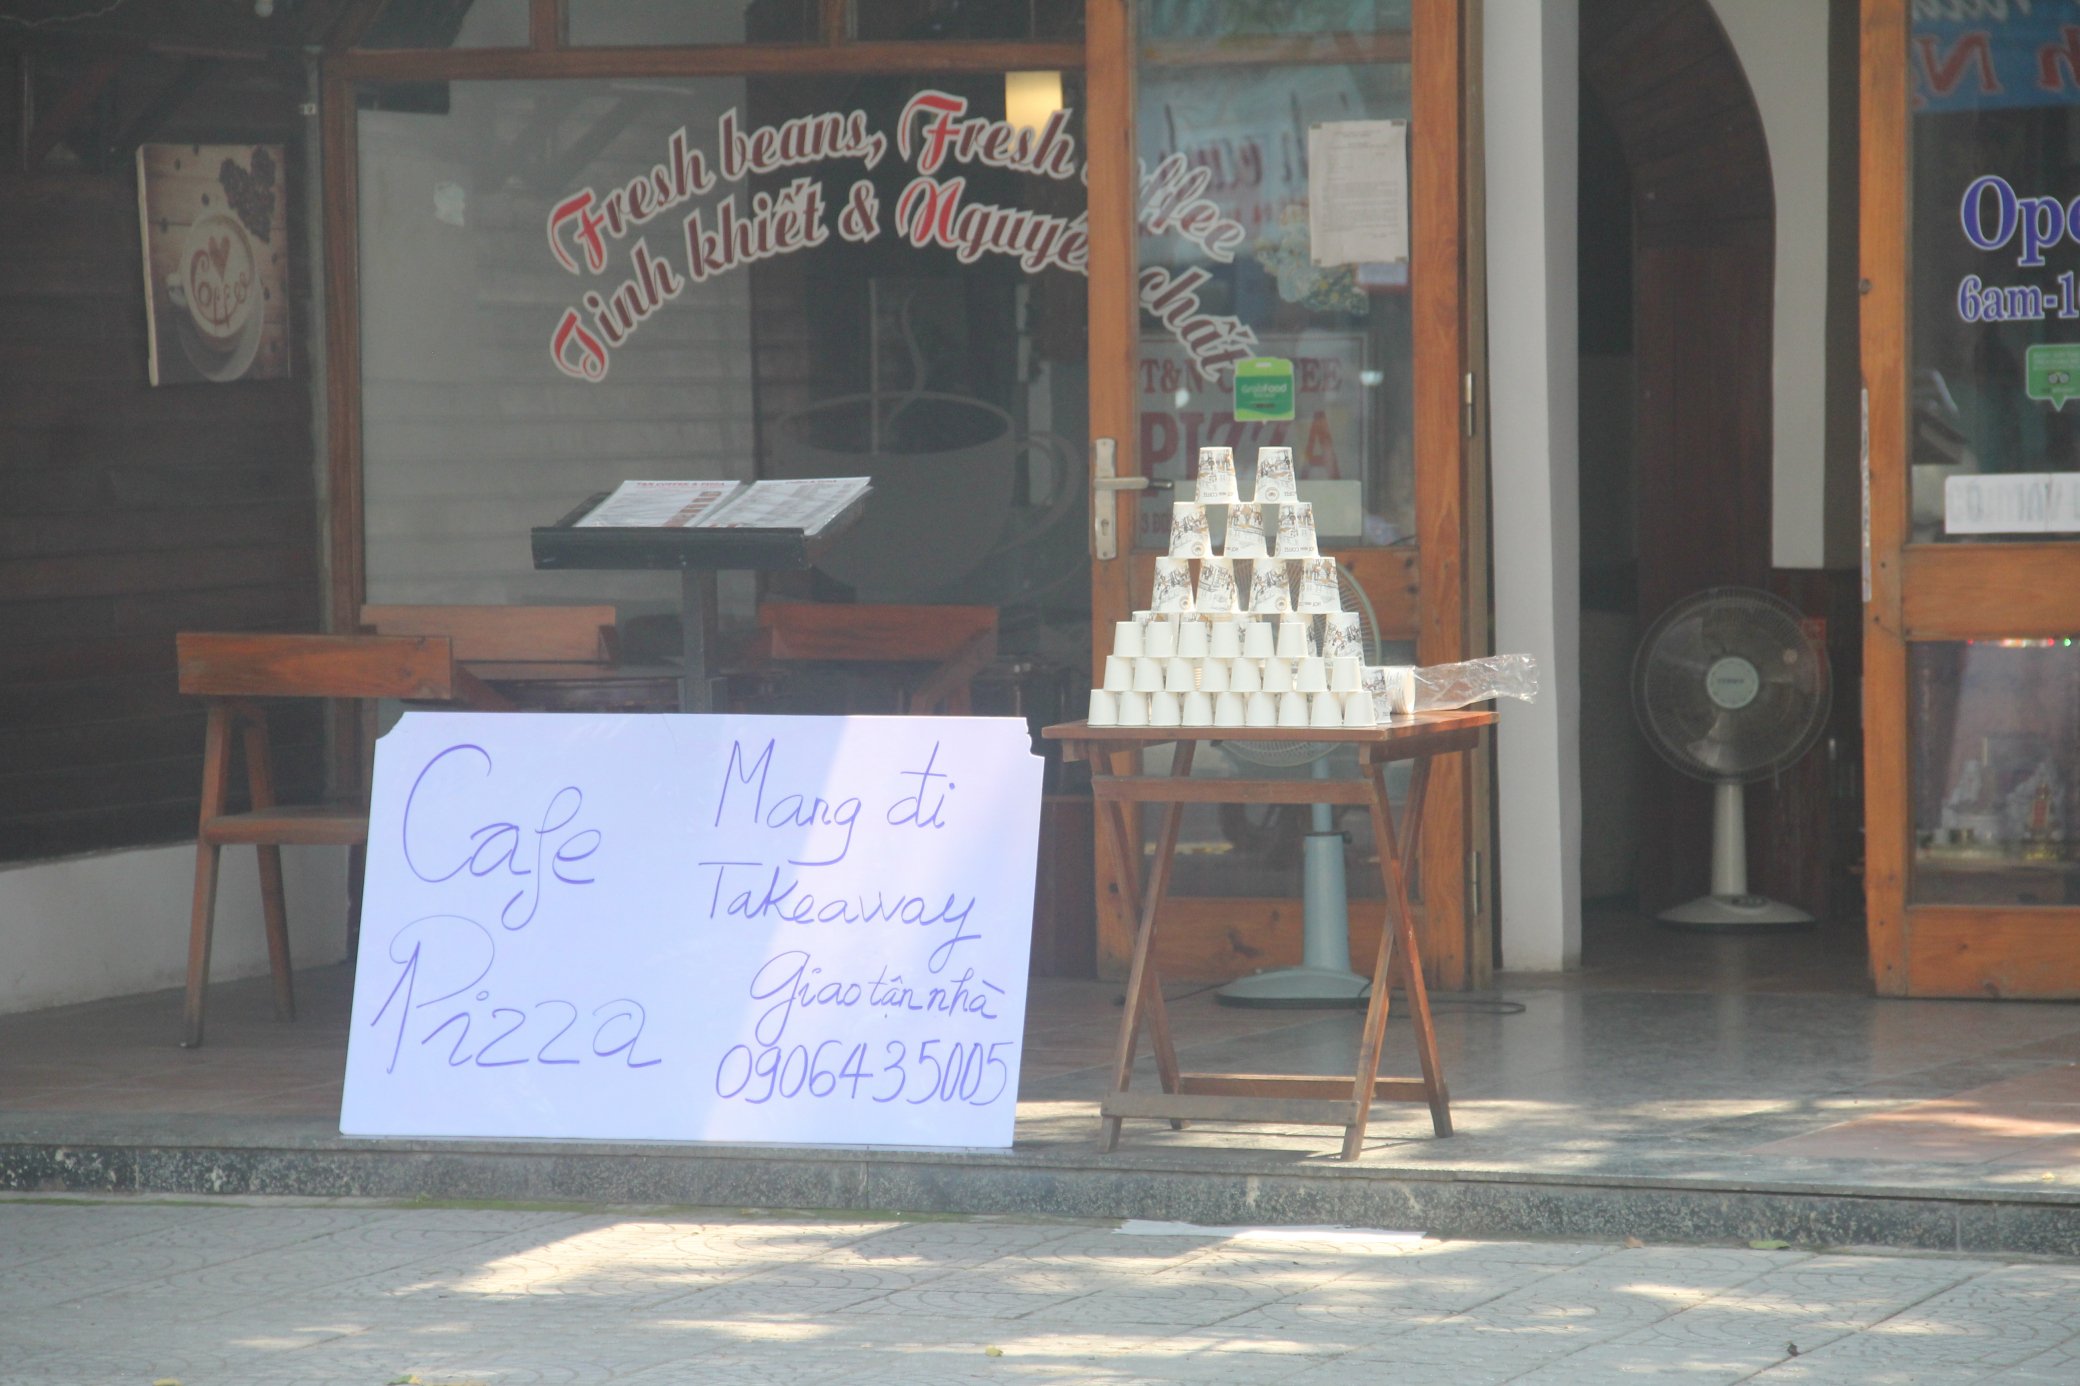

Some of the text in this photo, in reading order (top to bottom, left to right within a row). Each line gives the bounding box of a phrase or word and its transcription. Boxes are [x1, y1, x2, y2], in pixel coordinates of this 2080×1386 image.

[548, 126, 716, 274] Fresh
[717, 106, 886, 181] beans,
[899, 90, 1075, 178] Fresh
[1081, 152, 1246, 263] ffee
[838, 179, 880, 242] &
[896, 176, 1089, 277] Nguyê
[1957, 270, 2080, 323] 6am-1
[1217, 356, 1343, 394] CEE
[714, 737, 863, 867] Mang
[370, 914, 663, 1075] Pizza
[715, 1037, 1014, 1107] 0906435005
